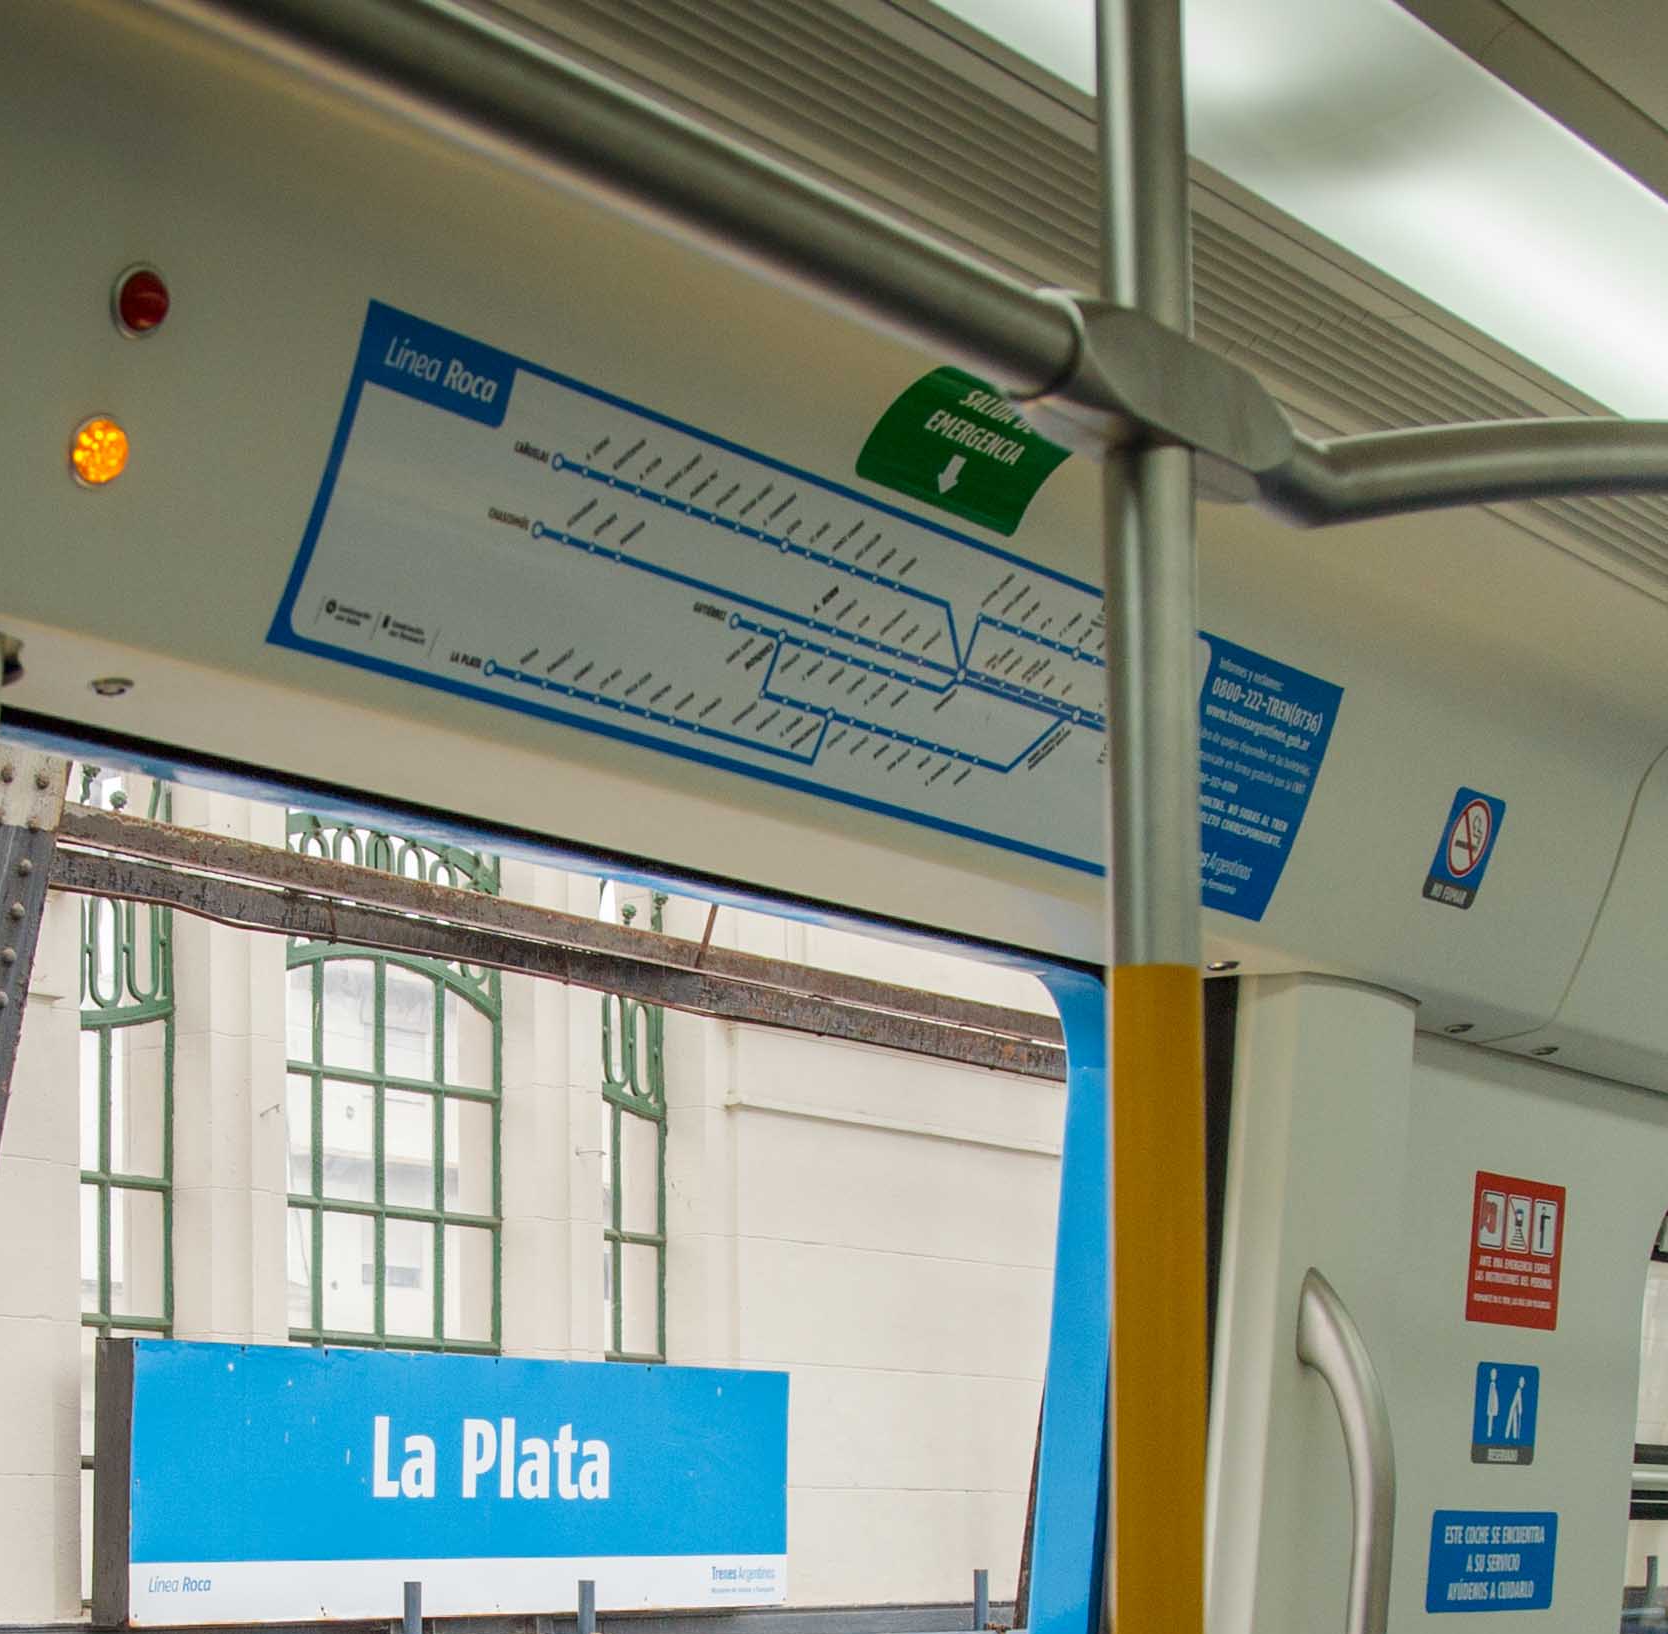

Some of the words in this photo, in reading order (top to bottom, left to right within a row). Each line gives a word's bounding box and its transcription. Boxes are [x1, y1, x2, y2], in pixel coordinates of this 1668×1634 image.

[384, 336, 443, 382] Línea
[443, 359, 497, 403] Roca
[959, 390, 1014, 426] SALIDA
[924, 409, 1026, 466] EMERGENCIA
[373, 1415, 436, 1498] La
[462, 1417, 611, 1500] Plata
[1444, 1526, 1464, 1544] ESTE
[1465, 1526, 1489, 1544] COCHE
[1491, 1526, 1501, 1544] SE
[1502, 1526, 1545, 1544] ENCUENTRA
[1466, 1554, 1473, 1572] A
[1475, 1554, 1485, 1572] SU
[1487, 1553, 1520, 1572] SERVICIO
[711, 1566, 736, 1580] Trenes
[739, 1565, 775, 1582] Argentinos
[148, 1576, 179, 1594] Línea
[182, 1576, 212, 1592] Roca
[1490, 1582, 1496, 1599] A
